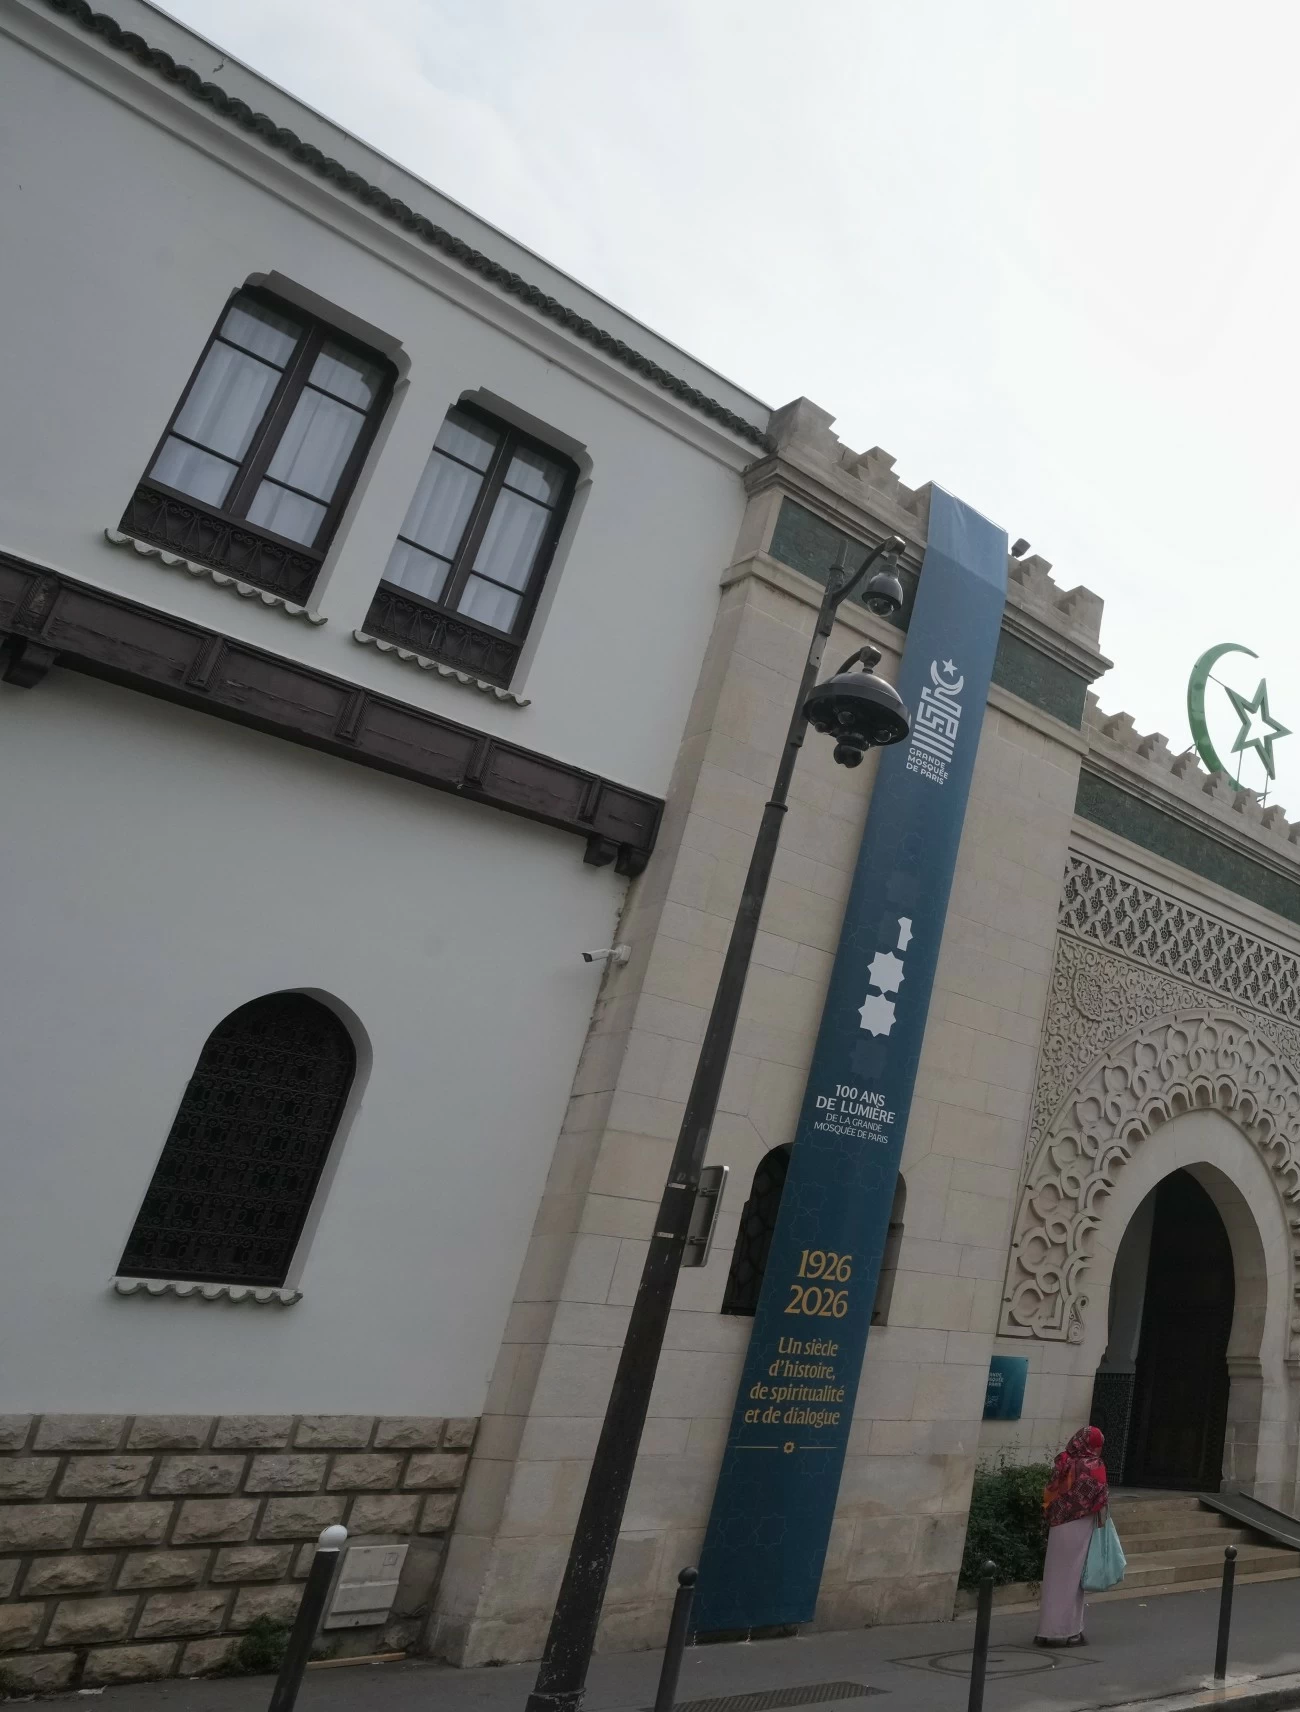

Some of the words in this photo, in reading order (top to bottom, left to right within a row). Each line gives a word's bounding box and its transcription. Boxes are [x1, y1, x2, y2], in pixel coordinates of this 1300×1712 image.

[908, 755, 949, 779] MOSQUÉE
[909, 748, 945, 768] GRANDE
[906, 762, 918, 772] DE
[921, 768, 943, 784] PARIS
[835, 1084, 858, 1099] 100
[860, 1091, 885, 1107] ANS
[816, 1096, 837, 1111] DE
[841, 1100, 896, 1124] LUMIÈRE
[814, 1121, 856, 1137] MOSQUÉE
[857, 1131, 866, 1139] DE
[868, 1133, 888, 1143] PARIS
[826, 1113, 838, 1123] DE
[840, 1115, 851, 1125] LA
[852, 1118, 883, 1133] GRANDE
[797, 1250, 853, 1283] 1926
[784, 1284, 849, 1319] 2026
[778, 1336, 802, 1354] Un
[804, 1338, 839, 1357] siècle
[769, 1359, 836, 1381] d'histoire,
[750, 1382, 769, 1400] de
[769, 1382, 845, 1403] spiritualité
[744, 1408, 760, 1424] et
[762, 1406, 781, 1424] de
[783, 1406, 840, 1429] dialogue
